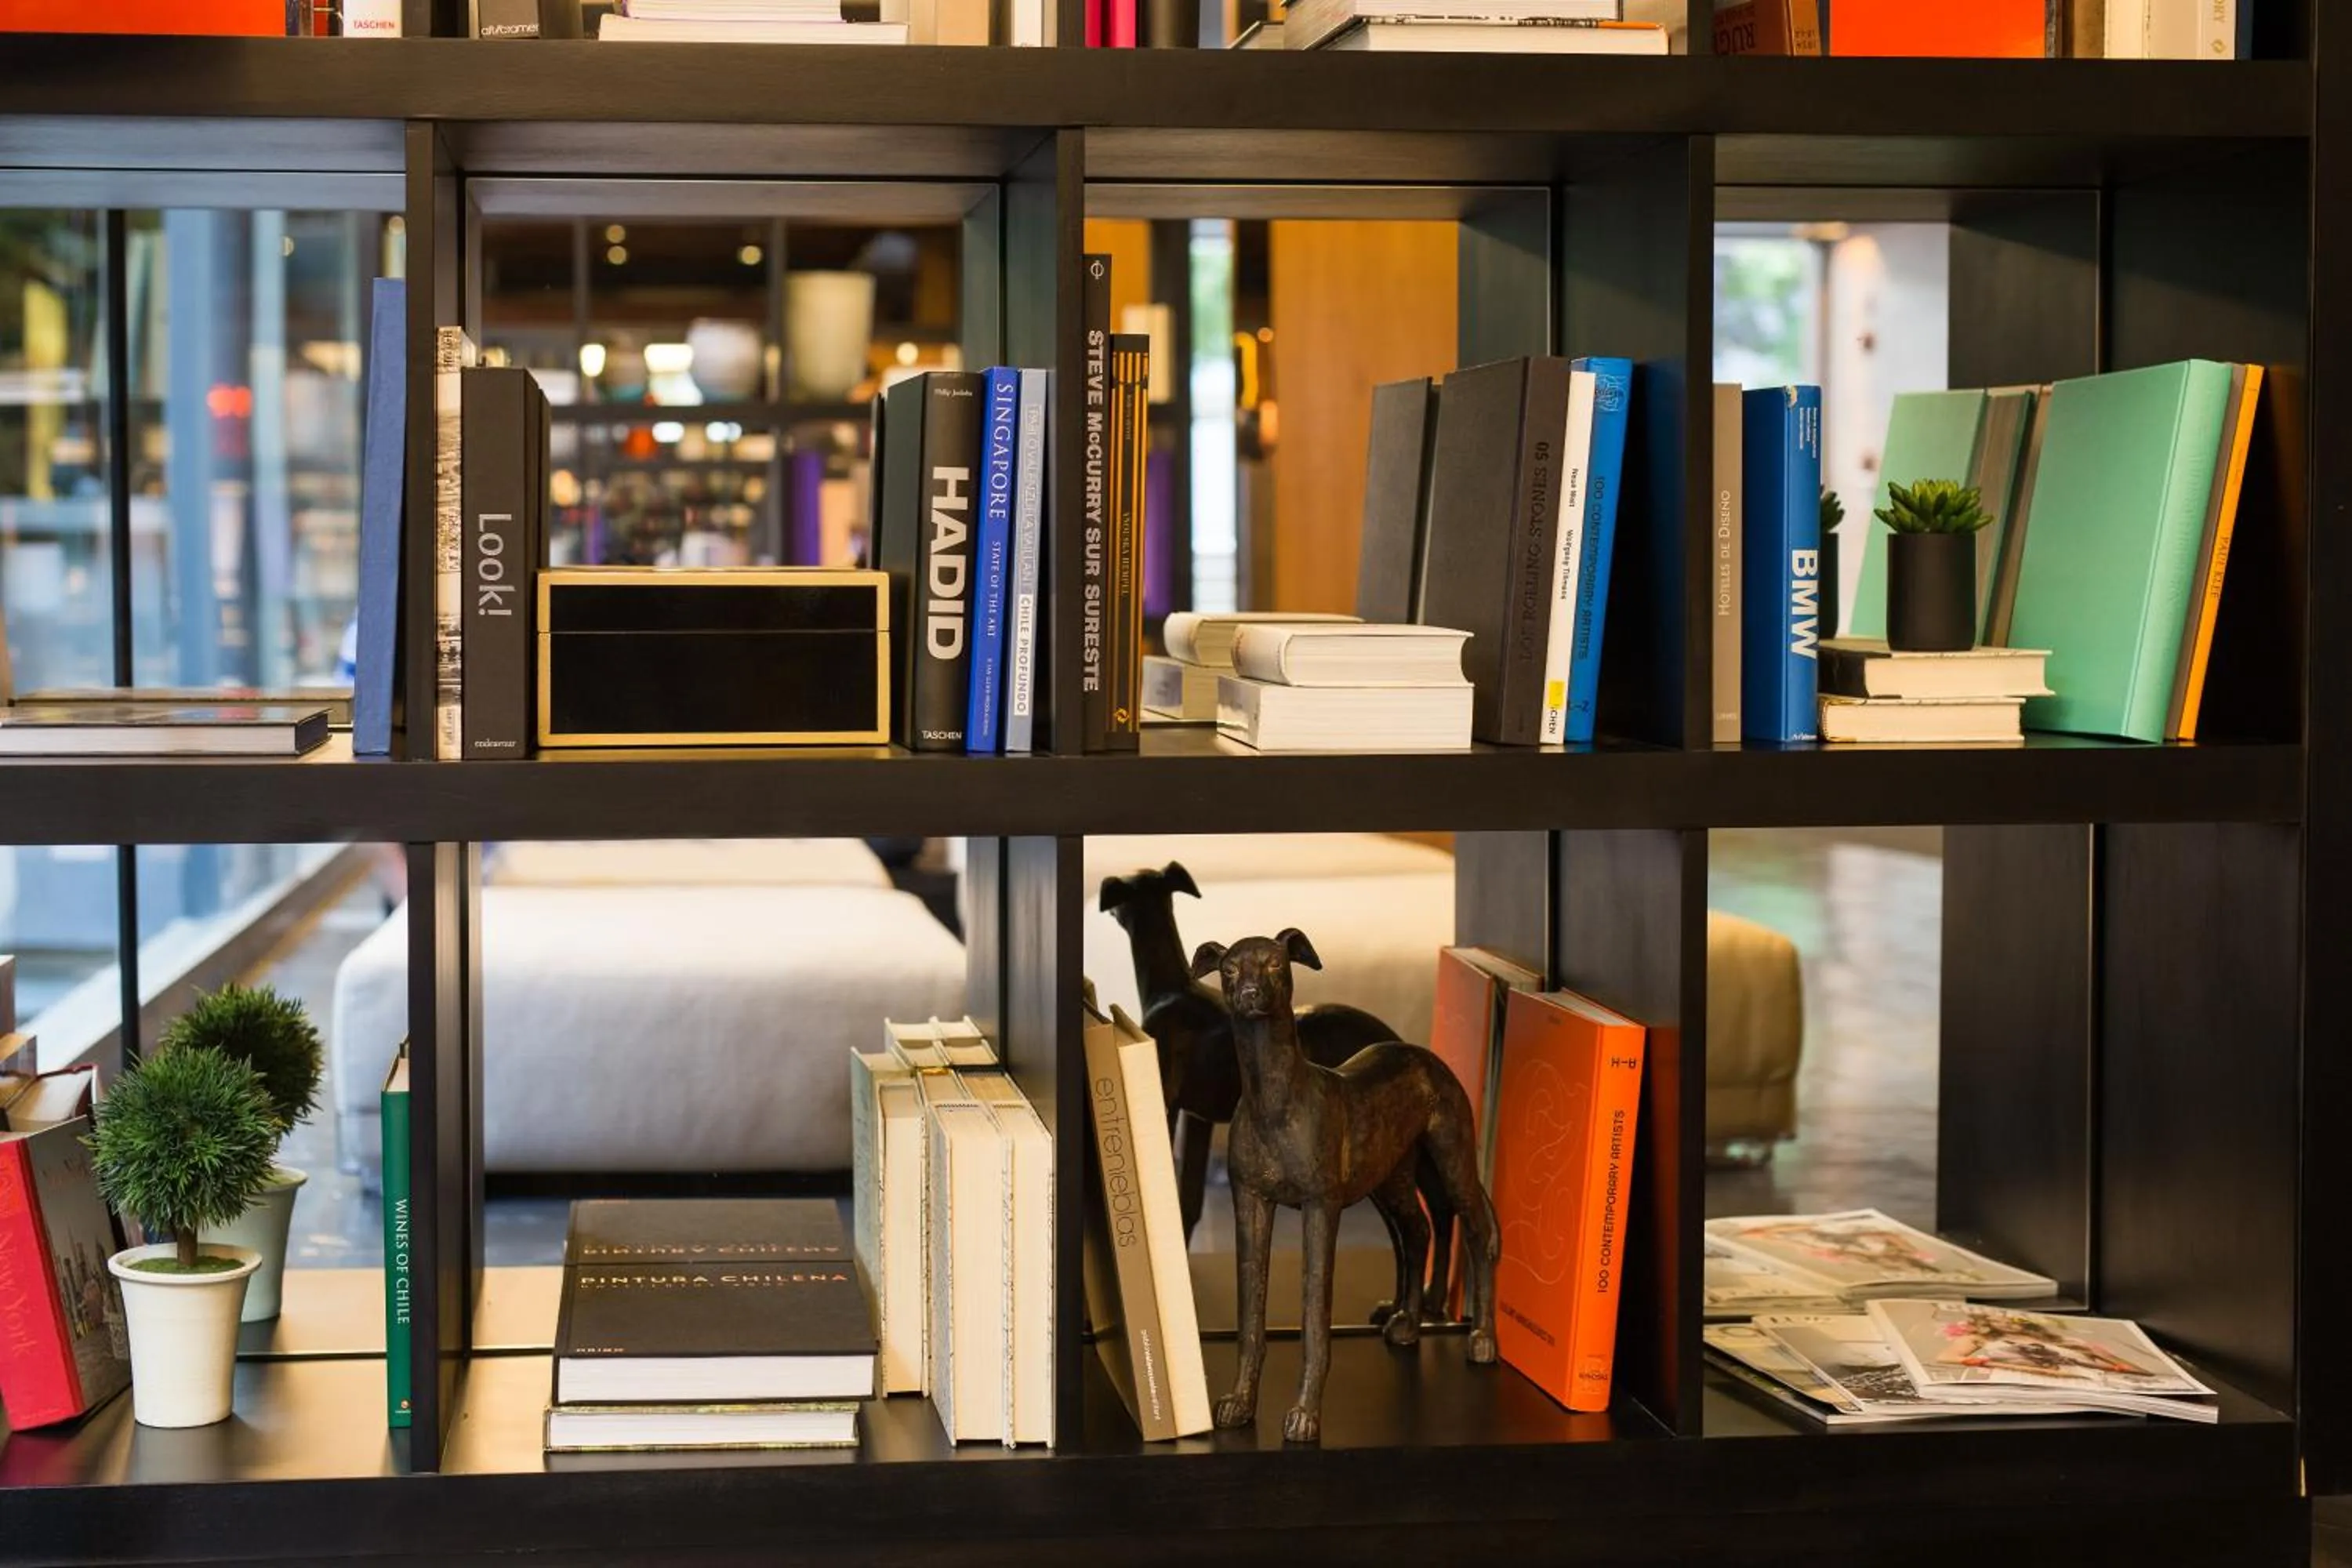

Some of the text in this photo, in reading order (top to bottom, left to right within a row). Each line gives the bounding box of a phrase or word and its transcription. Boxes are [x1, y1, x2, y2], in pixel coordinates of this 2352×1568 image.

[353, 19, 395, 30] TASCHEN
[1087, 330, 1104, 405] STEVE
[989, 383, 1013, 519] SINGAPORE
[1534, 441, 1550, 461] 50
[1084, 527, 1102, 576] SUR
[1530, 466, 1548, 539] STONES
[477, 513, 516, 617] Look!
[927, 466, 969, 660] HADID
[986, 541, 1001, 637] STATE OF THE ART
[1523, 543, 1543, 625] ROLLING
[1578, 475, 1606, 661] 100 CONTEMPORARY ARTISTS
[1791, 550, 1818, 659] BMW
[1016, 597, 1031, 712] CHILE PROFUNDO
[1083, 584, 1100, 693] SURESTE
[921, 729, 963, 740] TASCHEN
[1095, 1077, 1136, 1248] entrenieblas
[1597, 1109, 1625, 1293] 100 CONTEMPORARY ARTISTS
[395, 1199, 410, 1324] WINES OF CHILE
[580, 1274, 848, 1285] PINTURA CHILENA
[5, 1294, 38, 1358] York
